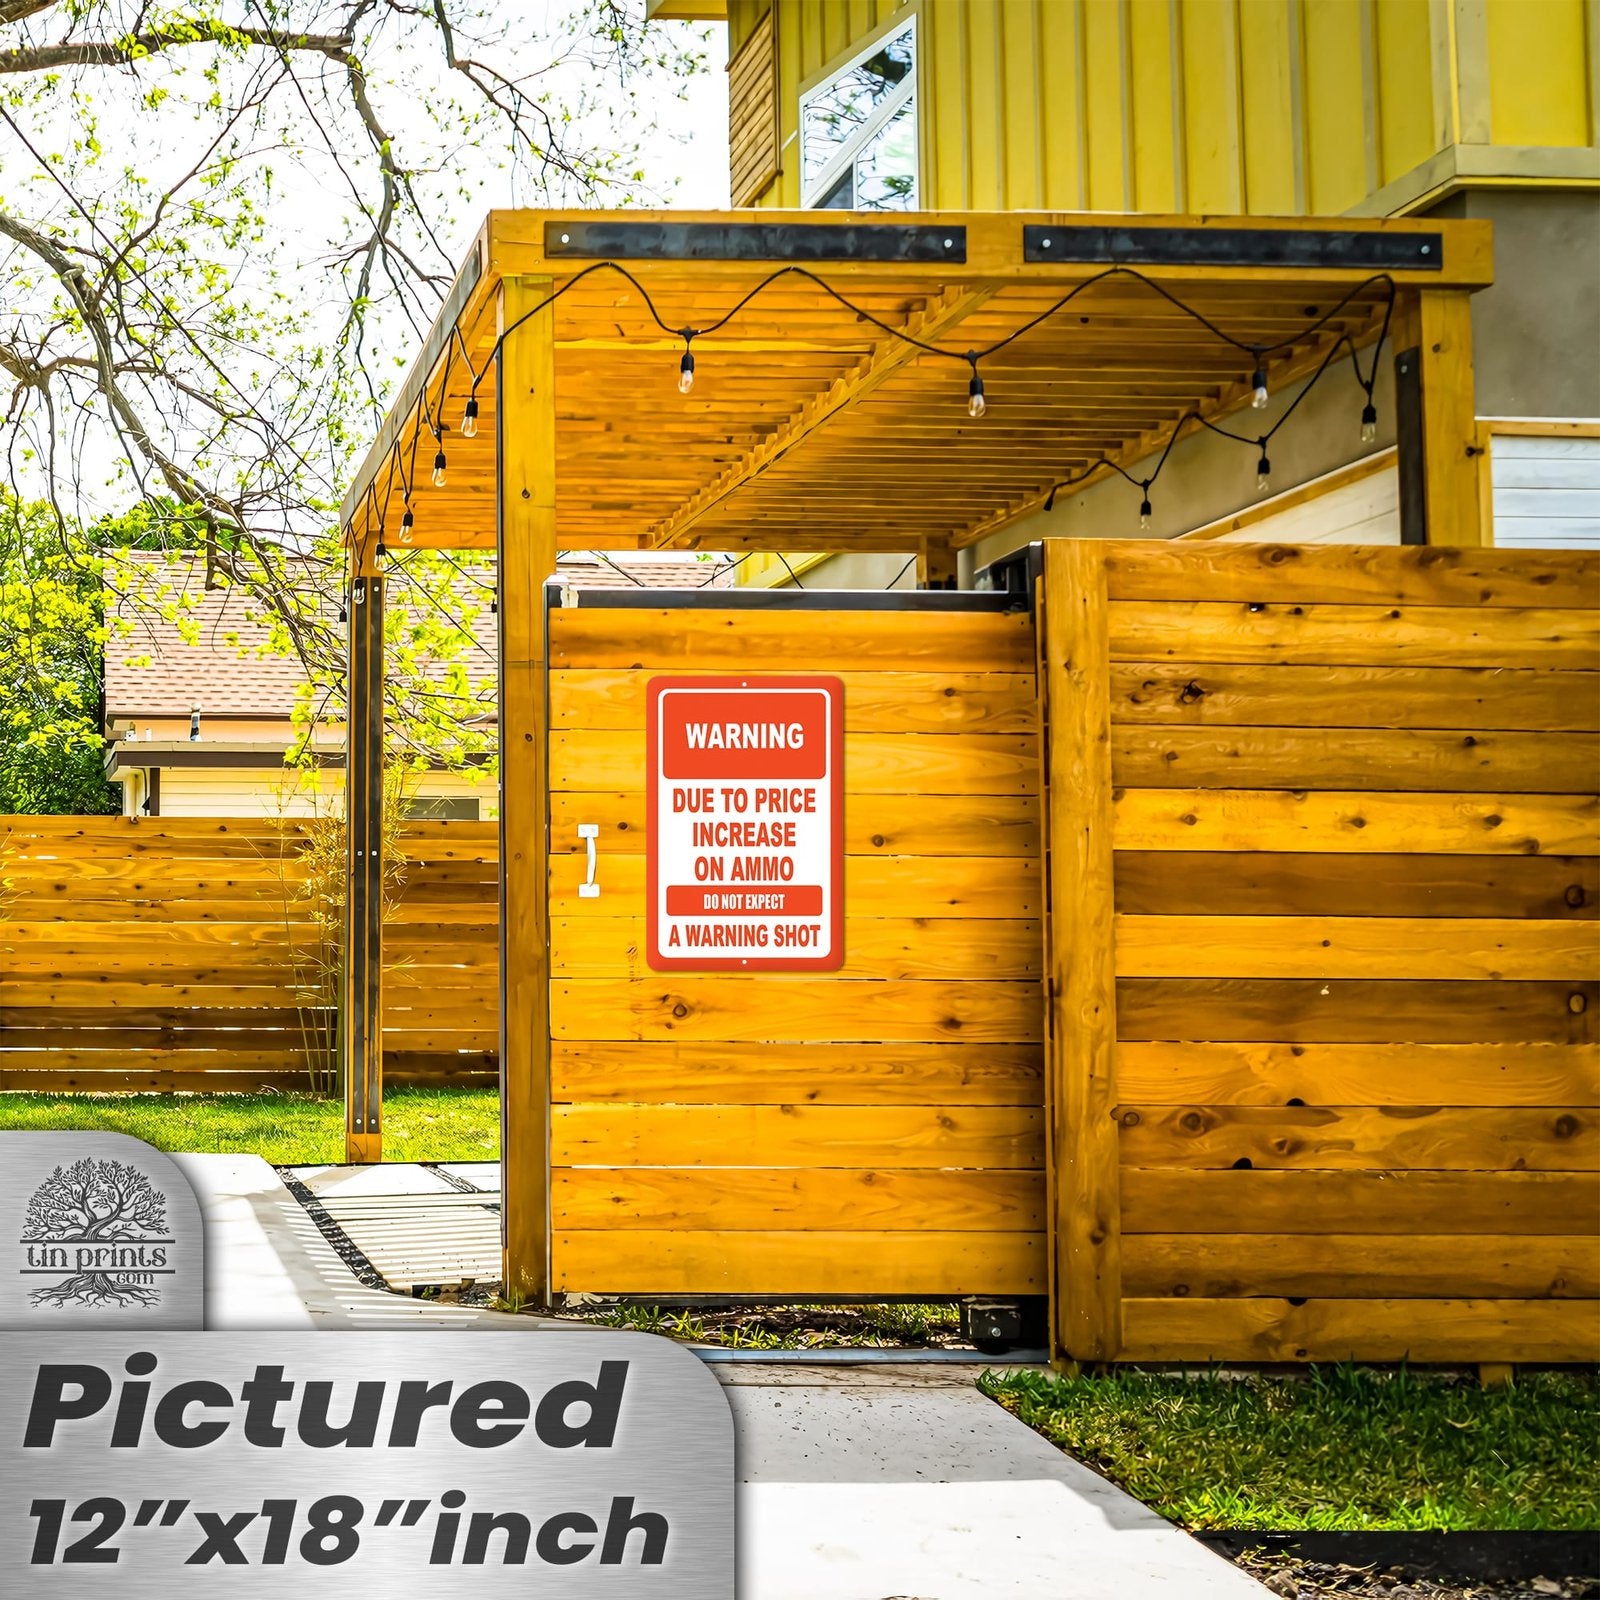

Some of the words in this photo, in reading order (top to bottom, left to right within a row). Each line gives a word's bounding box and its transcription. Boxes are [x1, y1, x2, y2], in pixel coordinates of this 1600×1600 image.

[685, 723, 804, 749] WARNING
[672, 788, 715, 813] DUE
[721, 788, 748, 813] TO
[755, 788, 816, 813] PRICE
[692, 822, 796, 847] INCREASE
[694, 856, 723, 881] ON
[730, 856, 794, 881] AMMO
[703, 893, 720, 910] DO
[721, 893, 744, 910] NOT
[745, 893, 785, 910] EXPECT
[668, 925, 680, 947] A
[685, 925, 769, 947] WARNING
[773, 925, 821, 947] SHOT
